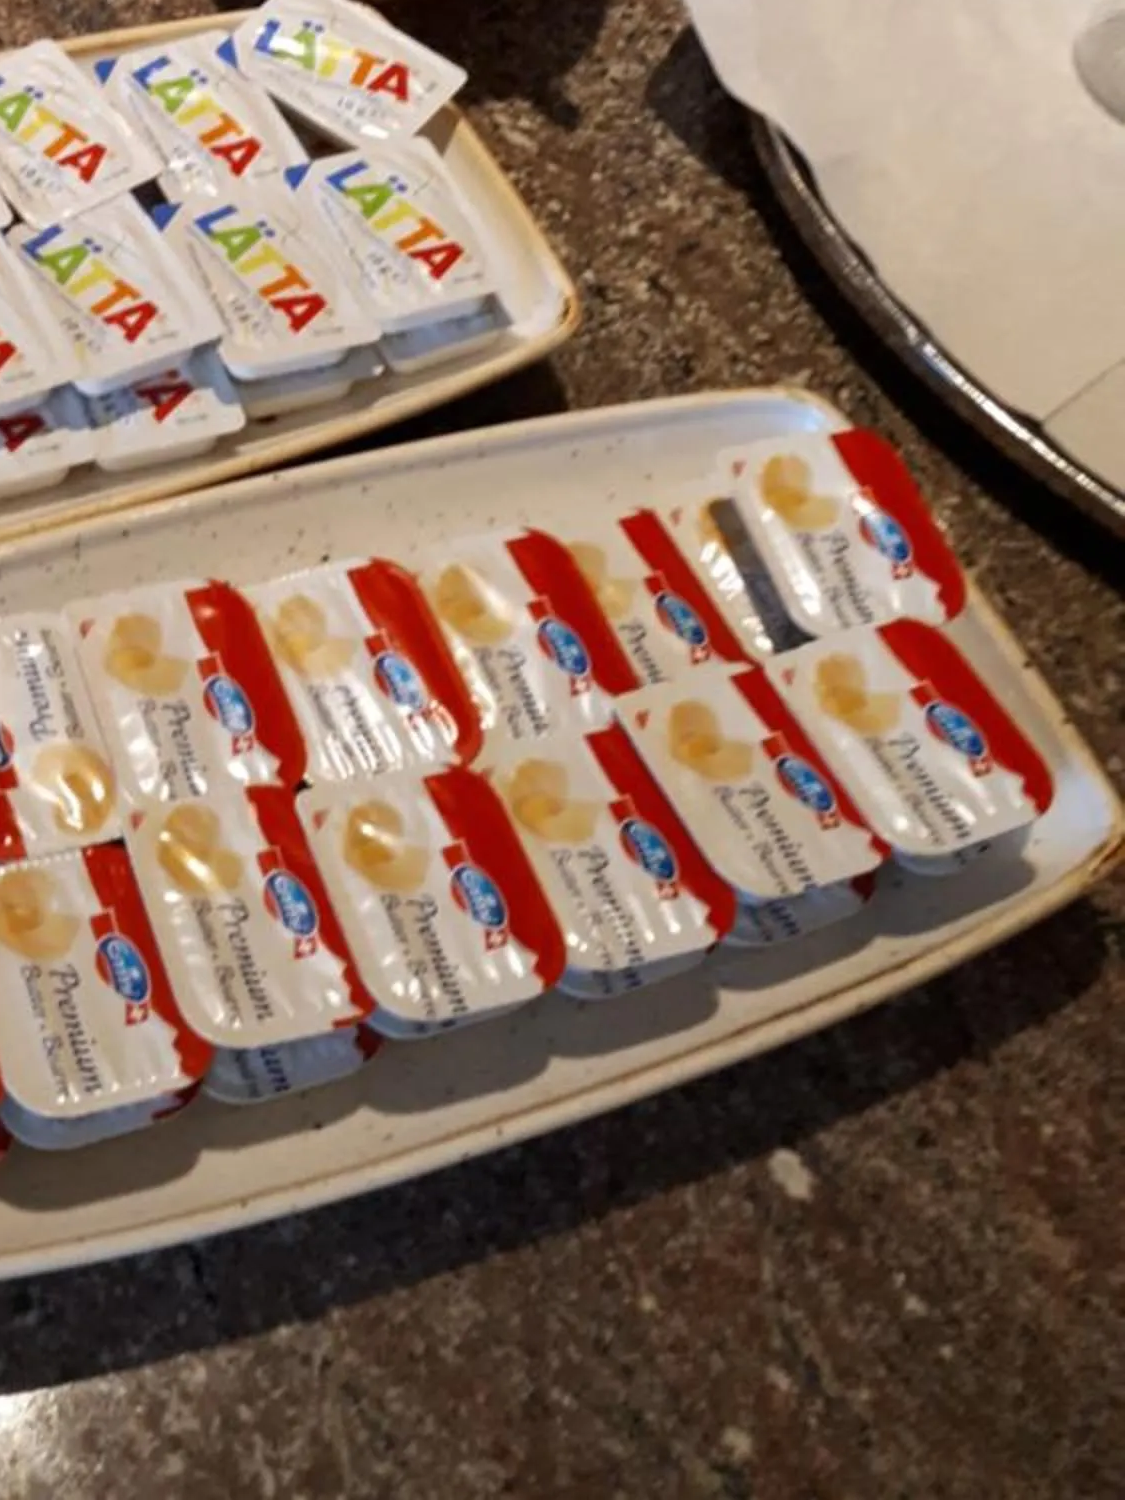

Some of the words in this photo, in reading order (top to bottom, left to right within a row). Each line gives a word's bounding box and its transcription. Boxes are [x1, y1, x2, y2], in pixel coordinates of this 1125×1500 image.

[132, 55, 262, 177] LÄTTA
[254, 19, 411, 102] LÄTTA
[194, 205, 327, 334] LÄTTA
[326, 161, 465, 280] LÄTTA
[22, 224, 159, 342] LÄTTA
[217, 897, 274, 1021] Premium
[406, 893, 468, 1015] Premium
[49, 964, 102, 1093] Premium
